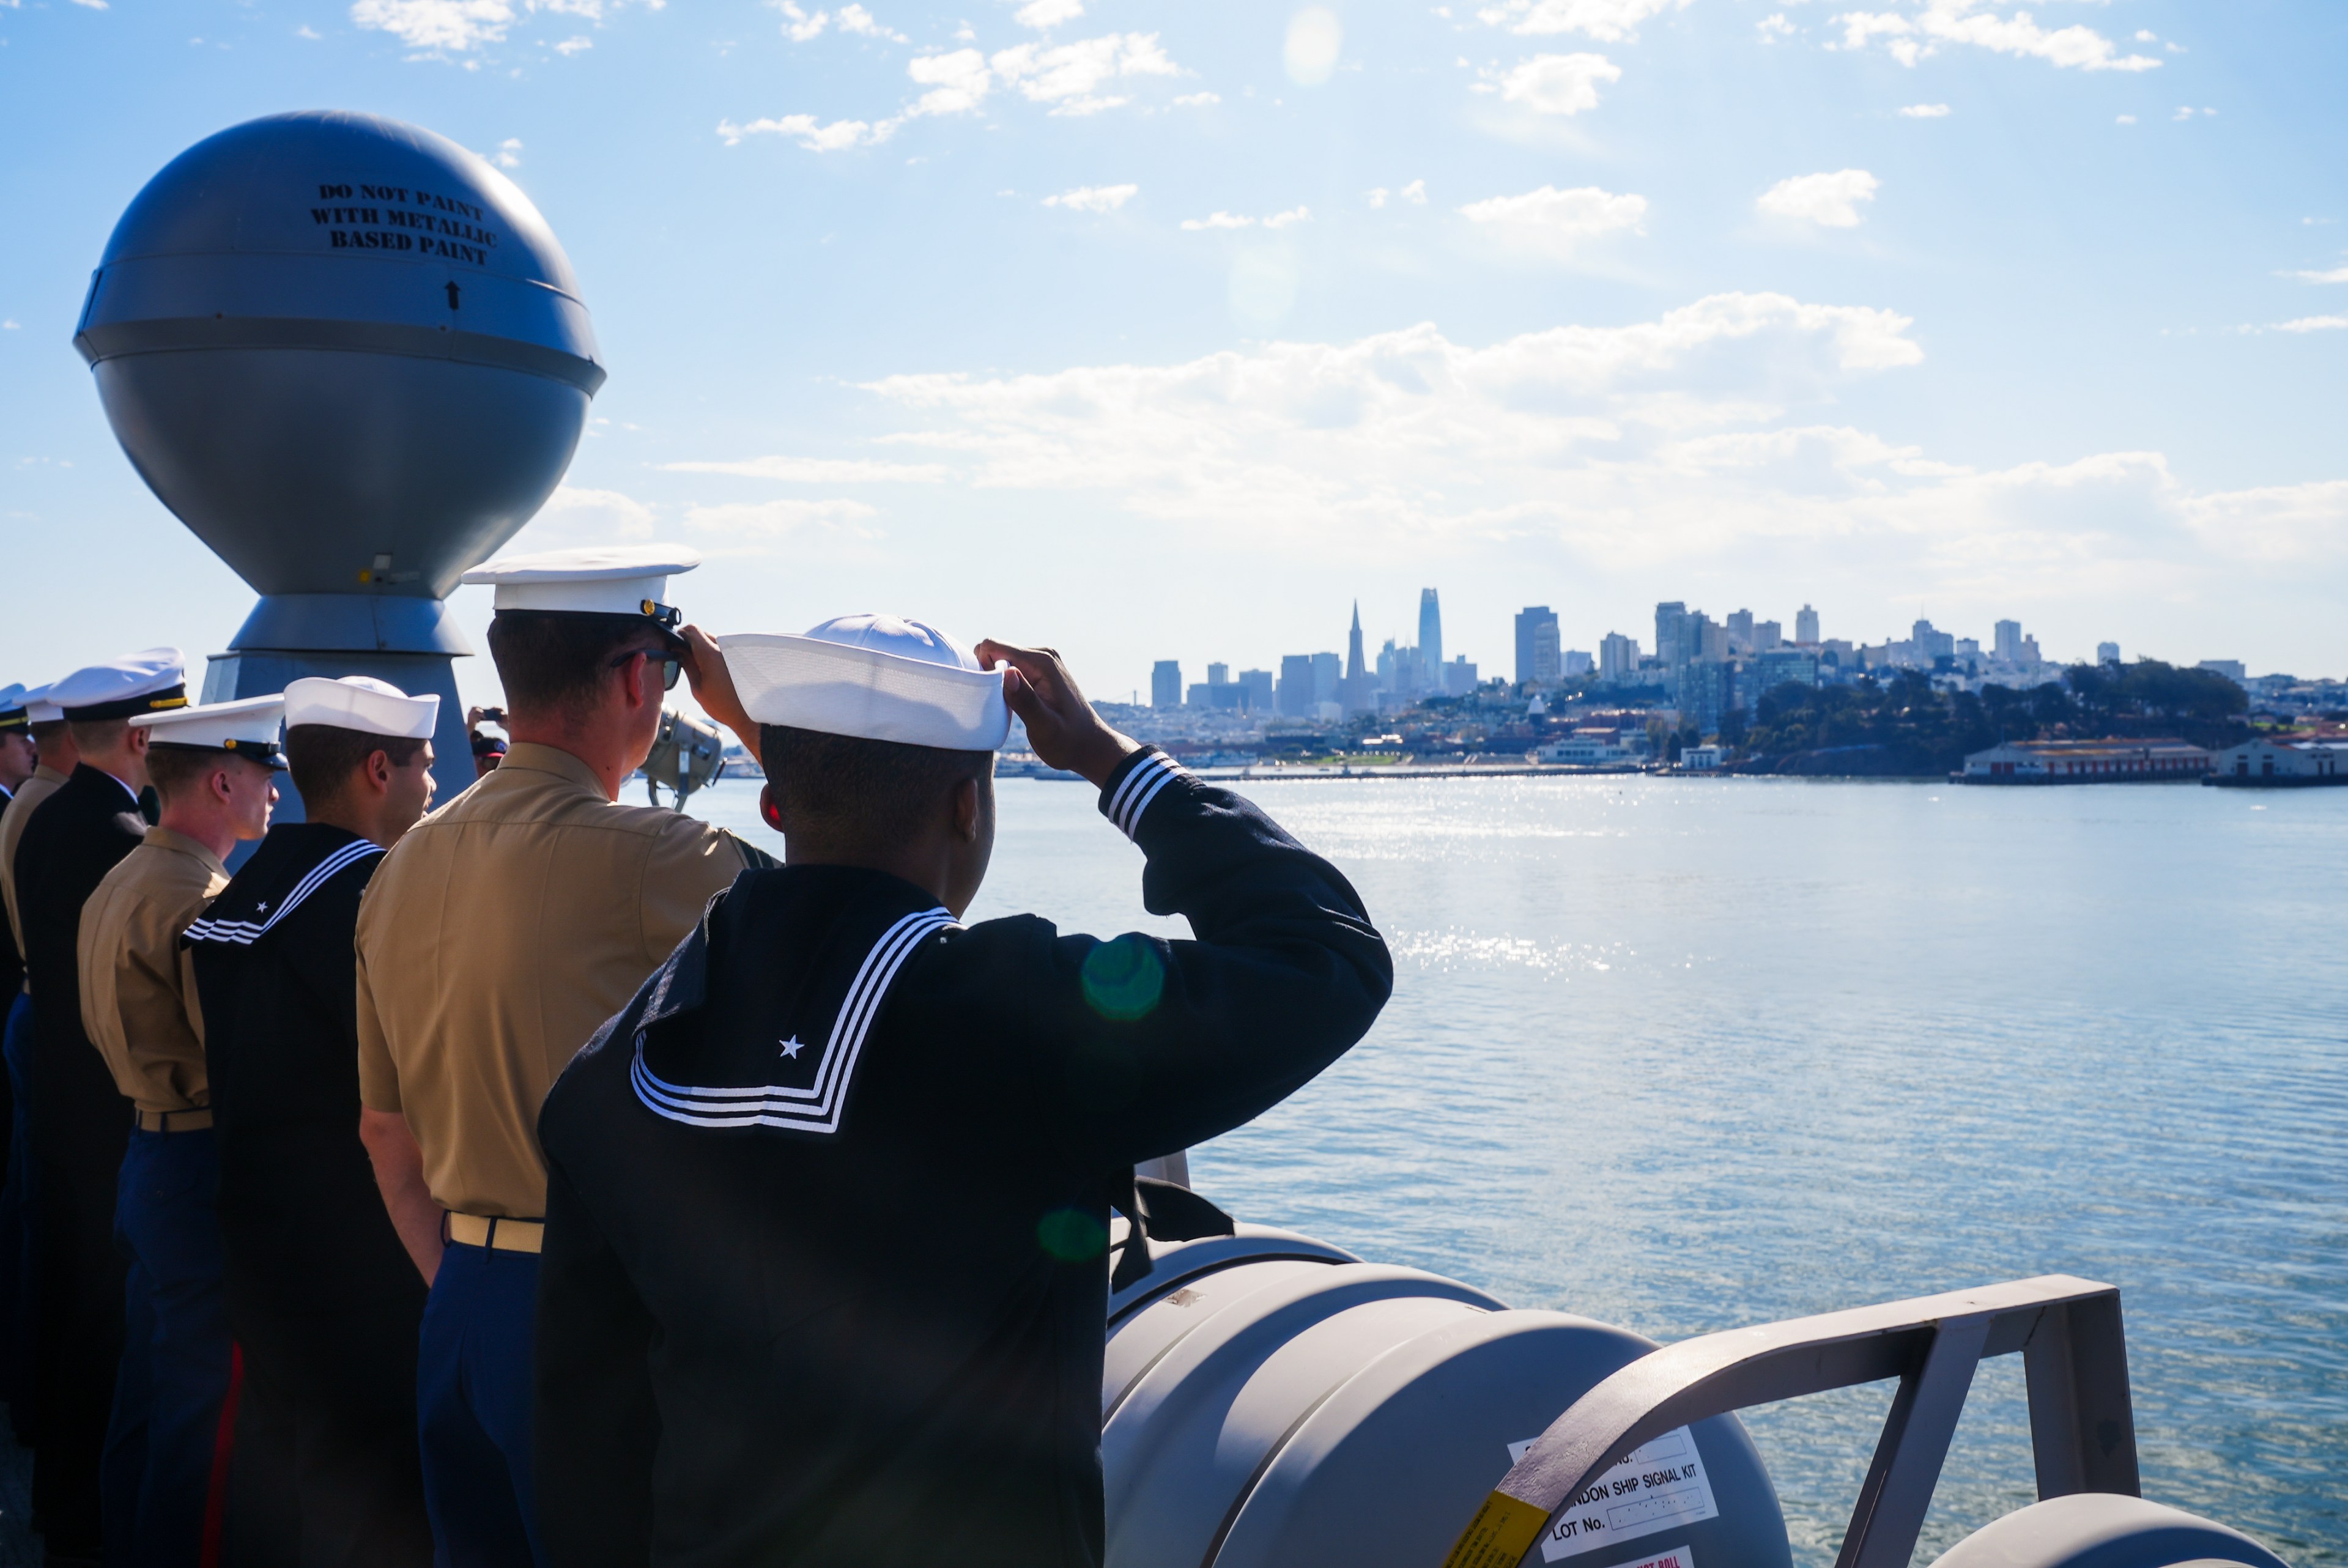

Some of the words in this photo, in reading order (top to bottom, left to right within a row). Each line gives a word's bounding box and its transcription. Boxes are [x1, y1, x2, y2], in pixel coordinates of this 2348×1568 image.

[319, 184, 353, 200] DO
[361, 185, 409, 202] NOT
[416, 190, 484, 221] PAINT
[311, 207, 379, 225] WITH
[387, 209, 498, 248] METALLIC
[330, 230, 412, 250] BASED
[419, 236, 487, 265] PAINT
[1612, 1477, 1639, 1496] SHIP
[1642, 1468, 1681, 1488] SIGNAL
[1681, 1463, 1697, 1479] KIT
[1552, 1520, 1577, 1541] LOT
[1582, 1517, 1605, 1533] No.
